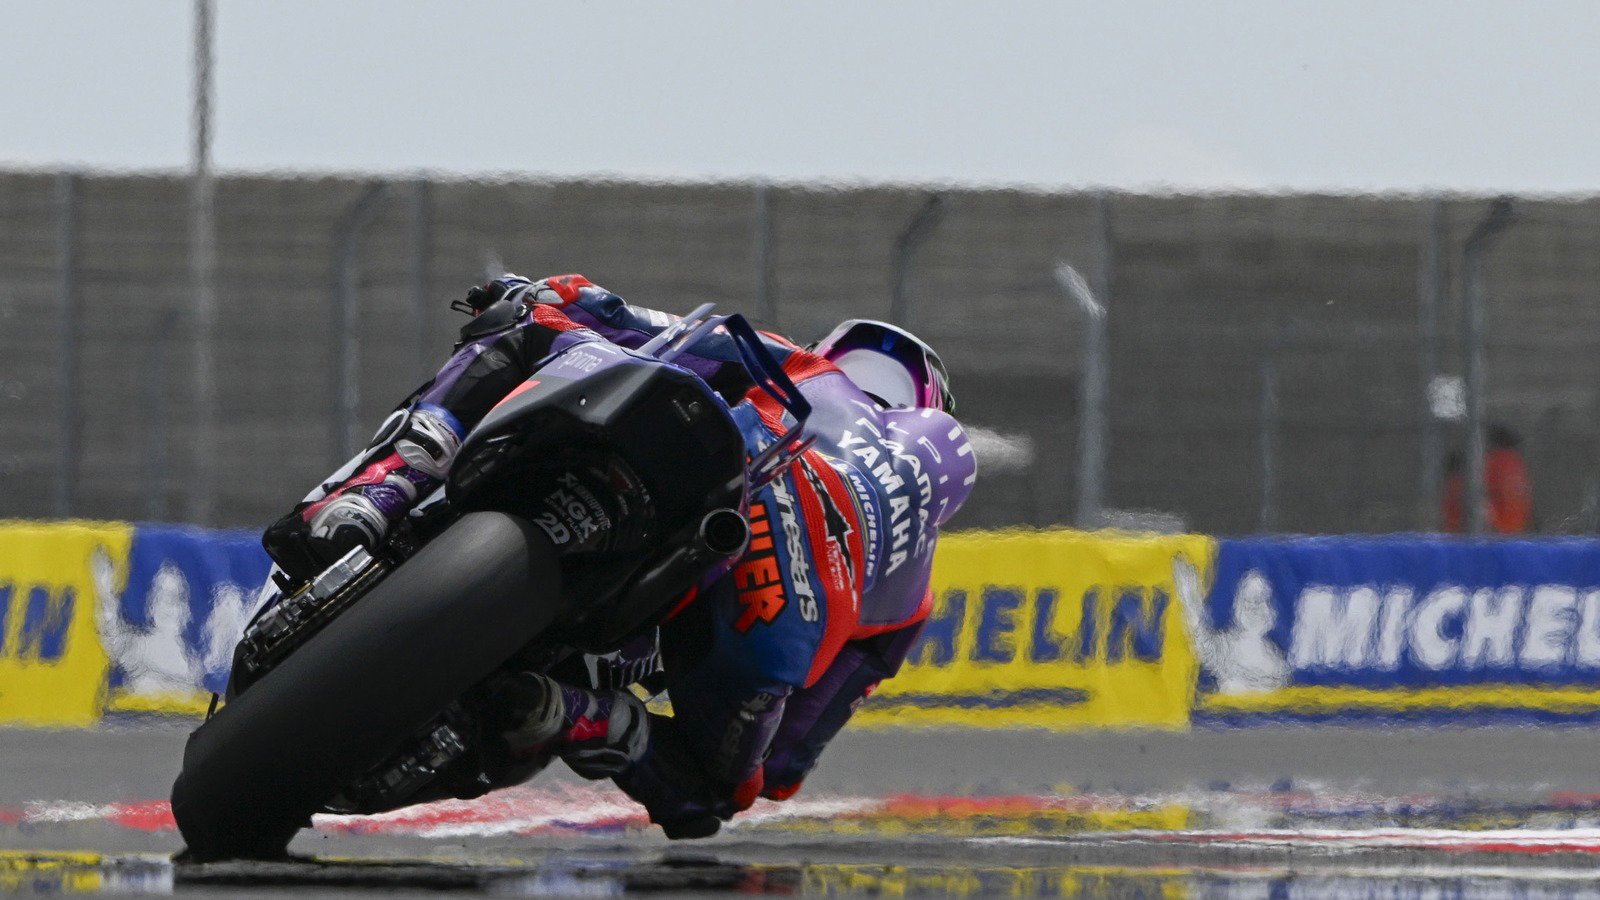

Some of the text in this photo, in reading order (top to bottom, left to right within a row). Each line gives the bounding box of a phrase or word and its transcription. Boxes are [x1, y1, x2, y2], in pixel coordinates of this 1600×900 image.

[532, 512, 571, 545] 2D
[550, 489, 600, 539] NGK
[837, 429, 912, 577] YAMAHA
[849, 474, 878, 577] MICHELIN
